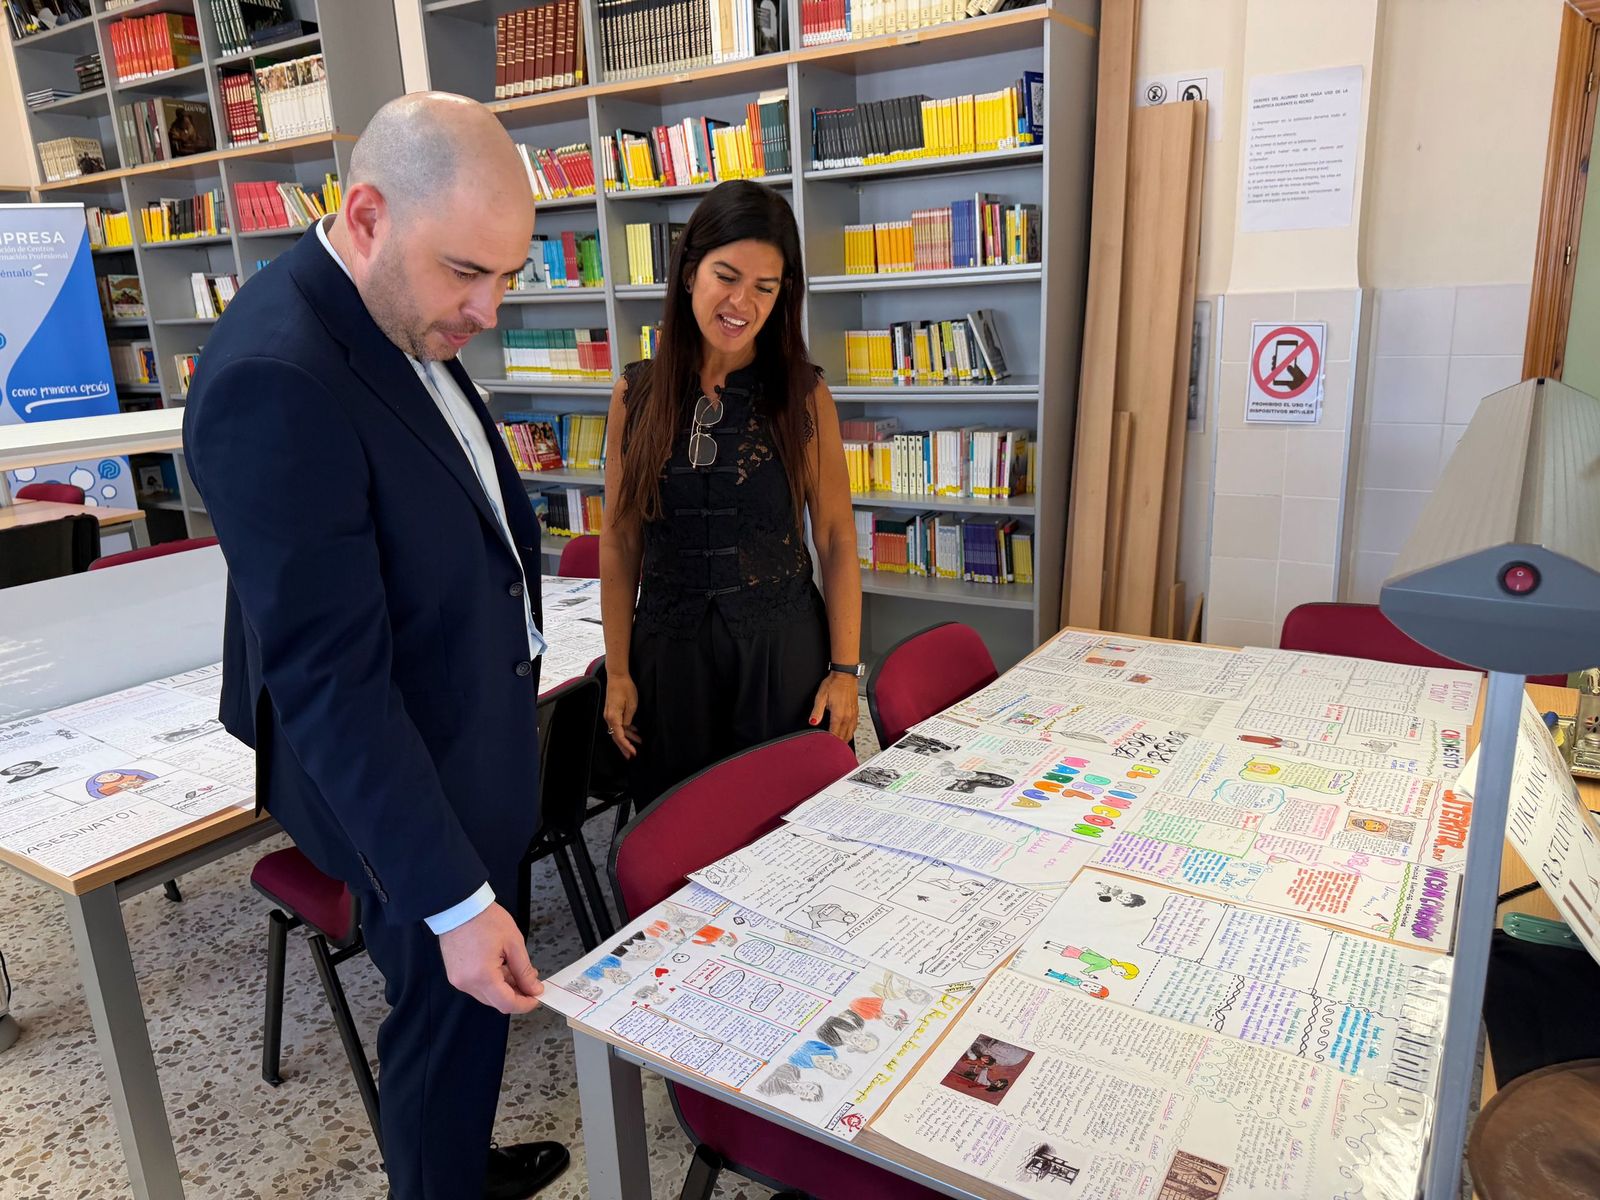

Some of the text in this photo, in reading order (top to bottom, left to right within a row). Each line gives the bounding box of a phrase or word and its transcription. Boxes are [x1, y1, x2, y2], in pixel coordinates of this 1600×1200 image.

[0, 231, 65, 245] PRESA
[1011, 755, 1091, 809] MARUJA
[1125, 763, 1161, 779] EL
[1061, 773, 1112, 801] DEL
[1071, 779, 1147, 839] RINCÓN
[976, 934, 1016, 961] PRESS
[935, 993, 963, 1012] El
